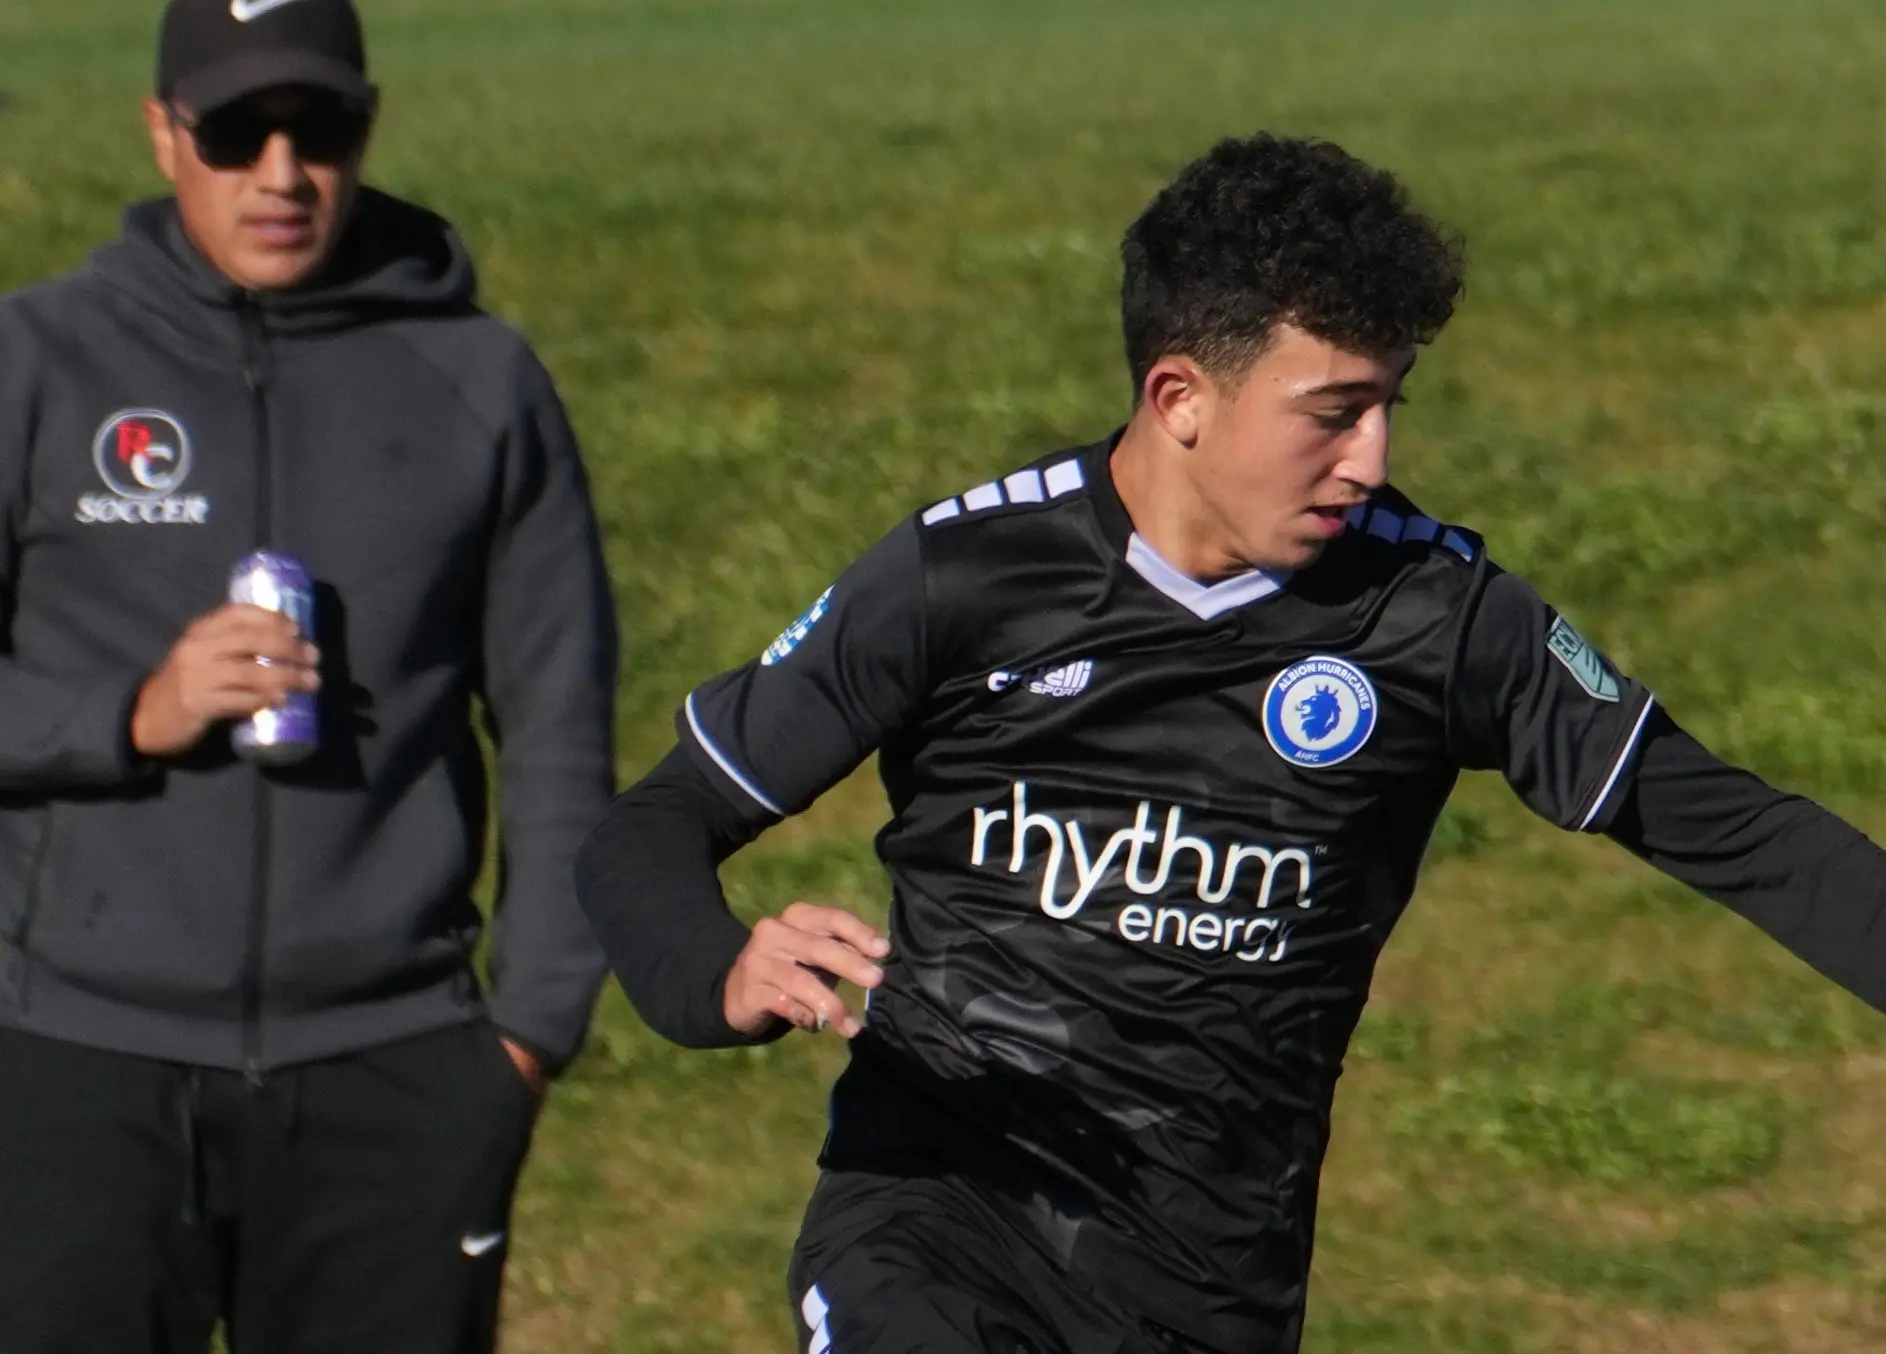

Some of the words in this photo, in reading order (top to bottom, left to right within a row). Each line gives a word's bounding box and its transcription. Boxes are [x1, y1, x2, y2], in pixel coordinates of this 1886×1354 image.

[75, 496, 208, 524] SOCCER
[1030, 682, 1083, 698] SPORT
[1278, 662, 1317, 692] ALBION
[1317, 662, 1371, 711] HURRICANES
[1294, 749, 1321, 763] AHFC
[970, 781, 1312, 920] rhythm
